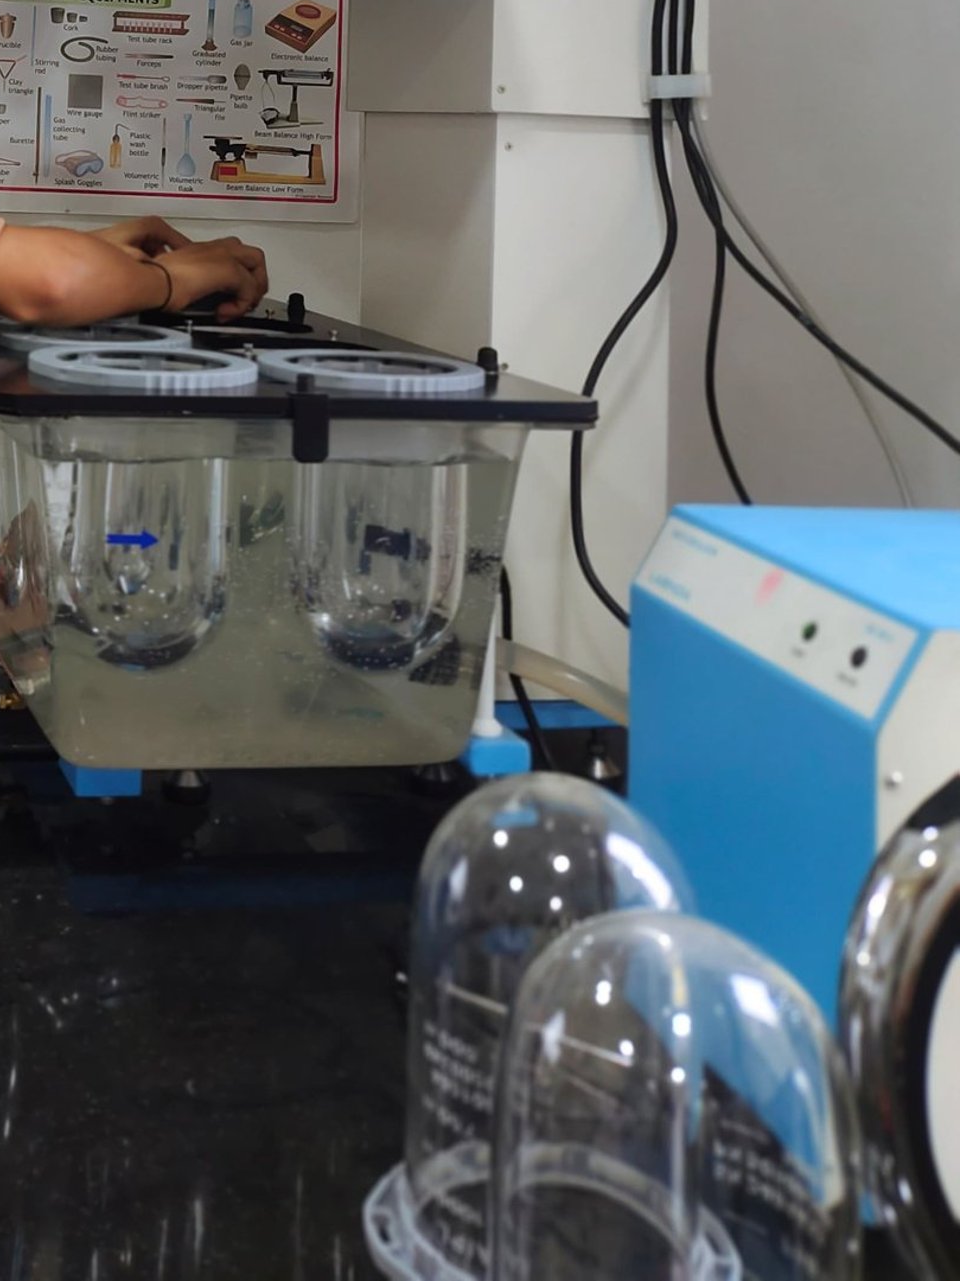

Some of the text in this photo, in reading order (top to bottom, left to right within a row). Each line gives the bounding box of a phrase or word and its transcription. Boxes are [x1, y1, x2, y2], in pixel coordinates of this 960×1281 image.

[96, 54, 116, 62] tubing
[35, 59, 59, 67] Stirring
[137, 60, 161, 68] Forceps
[9, 78, 22, 86] Clay
[177, 82, 203, 91] Dropper
[54, 126, 85, 134] collecting
[124, 172, 159, 180] Volumetric
[169, 177, 203, 185] Volumetric
